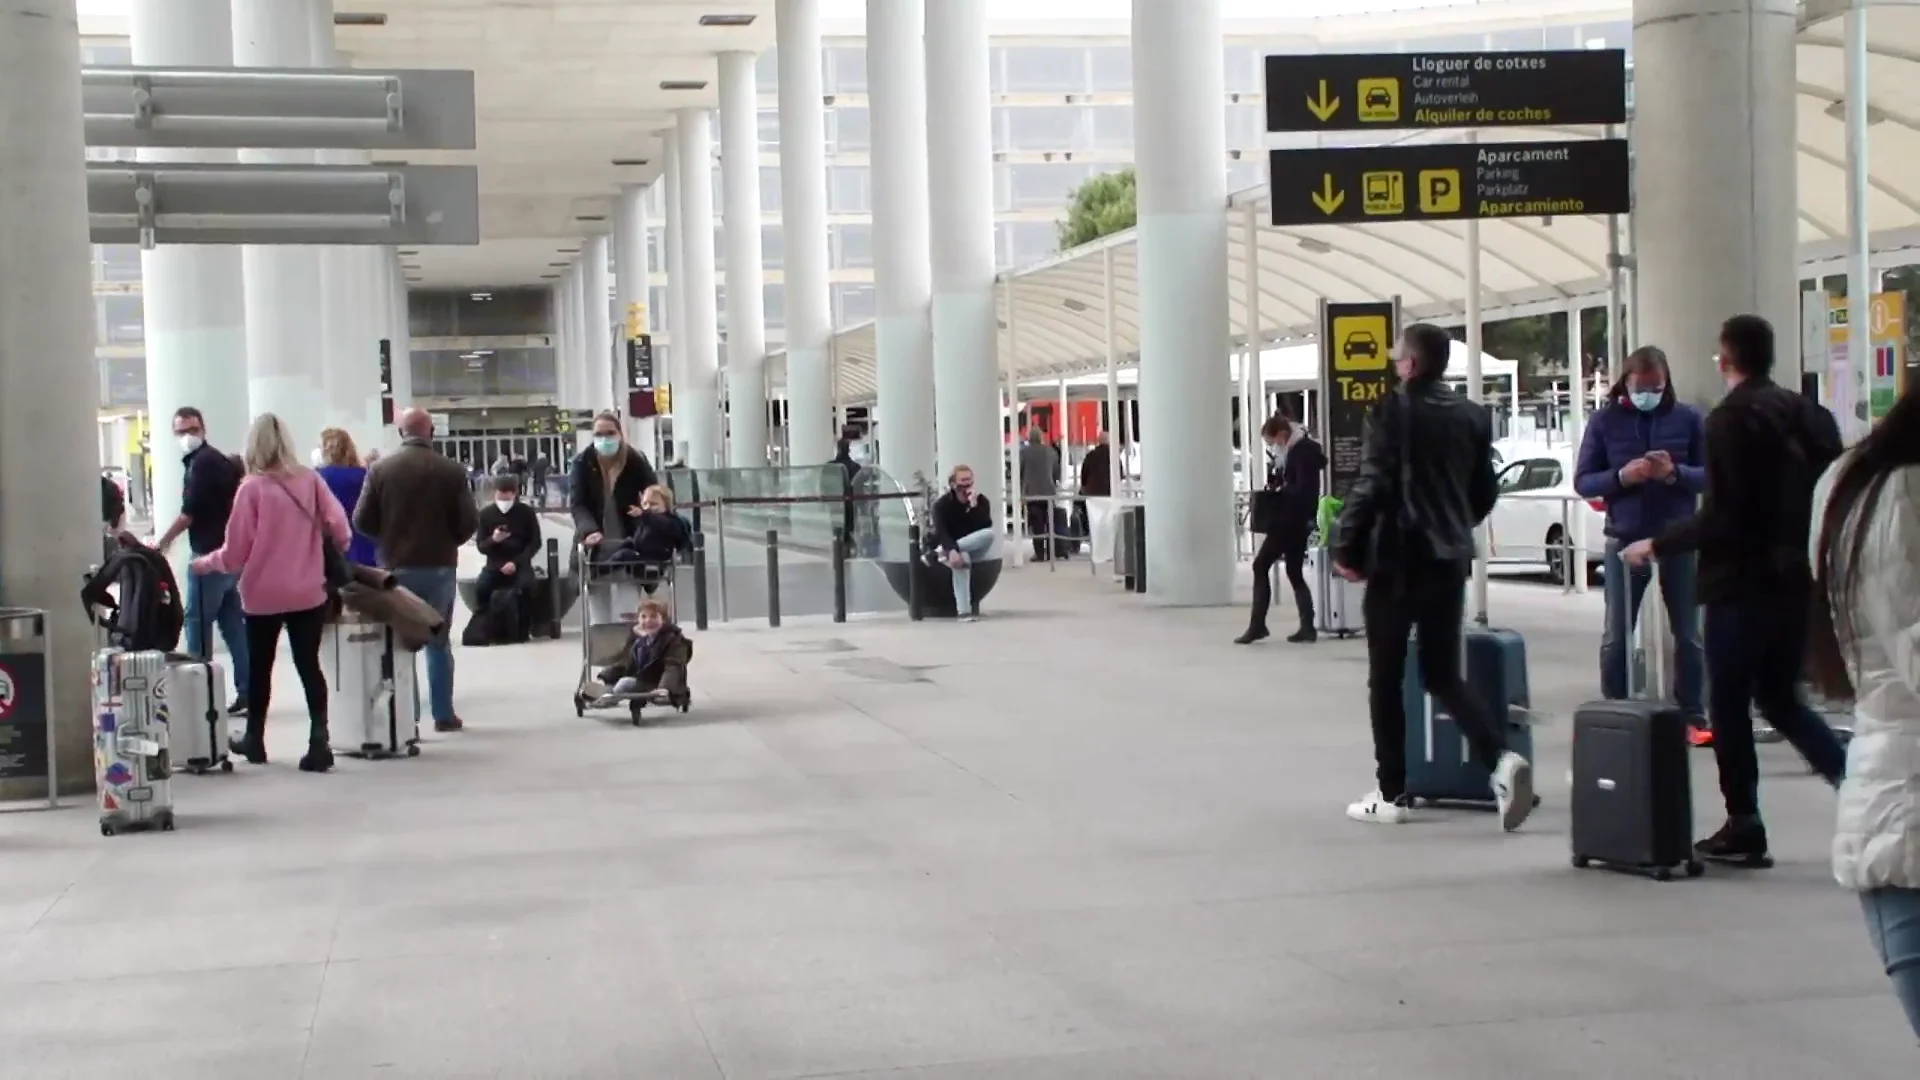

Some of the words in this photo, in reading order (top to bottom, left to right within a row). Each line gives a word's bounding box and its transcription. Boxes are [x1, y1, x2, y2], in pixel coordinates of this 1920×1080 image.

[1412, 57, 1470, 74] Lloguer
[1474, 56, 1493, 70] de
[1496, 56, 1547, 70] cotxes
[1413, 75, 1433, 88] Car
[1436, 75, 1470, 88] rental
[1414, 92, 1479, 105] Autoverleih
[1415, 108, 1472, 125] Alquiler
[1476, 108, 1494, 121] de
[1498, 106, 1551, 120] coches
[1477, 147, 1570, 165] Aparcament
[1476, 166, 1520, 181] Parking
[1431, 177, 1451, 206] P
[1477, 183, 1529, 196] Parkplatz
[1479, 196, 1584, 216] Aparcamiento
[1336, 376, 1386, 401] Taxi
